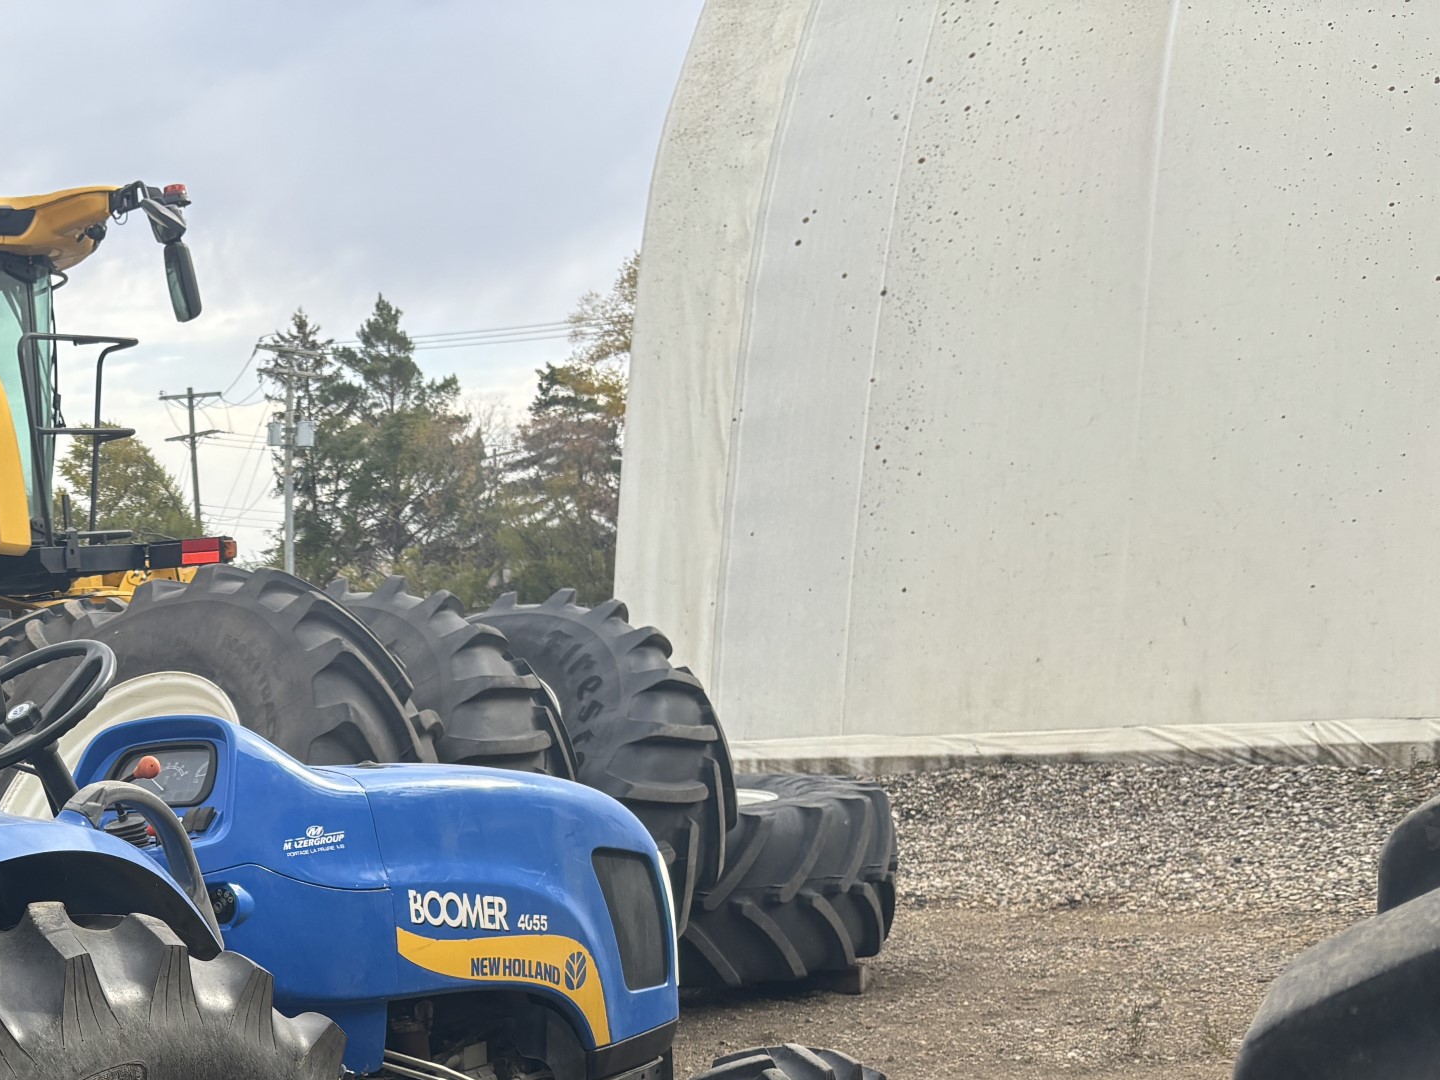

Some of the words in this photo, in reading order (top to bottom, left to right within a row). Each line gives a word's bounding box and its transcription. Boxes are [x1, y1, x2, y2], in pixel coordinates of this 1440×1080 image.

[407, 889, 510, 931] BOOMER
[470, 957, 501, 977] NEW
[502, 957, 561, 986] HOLLAND
